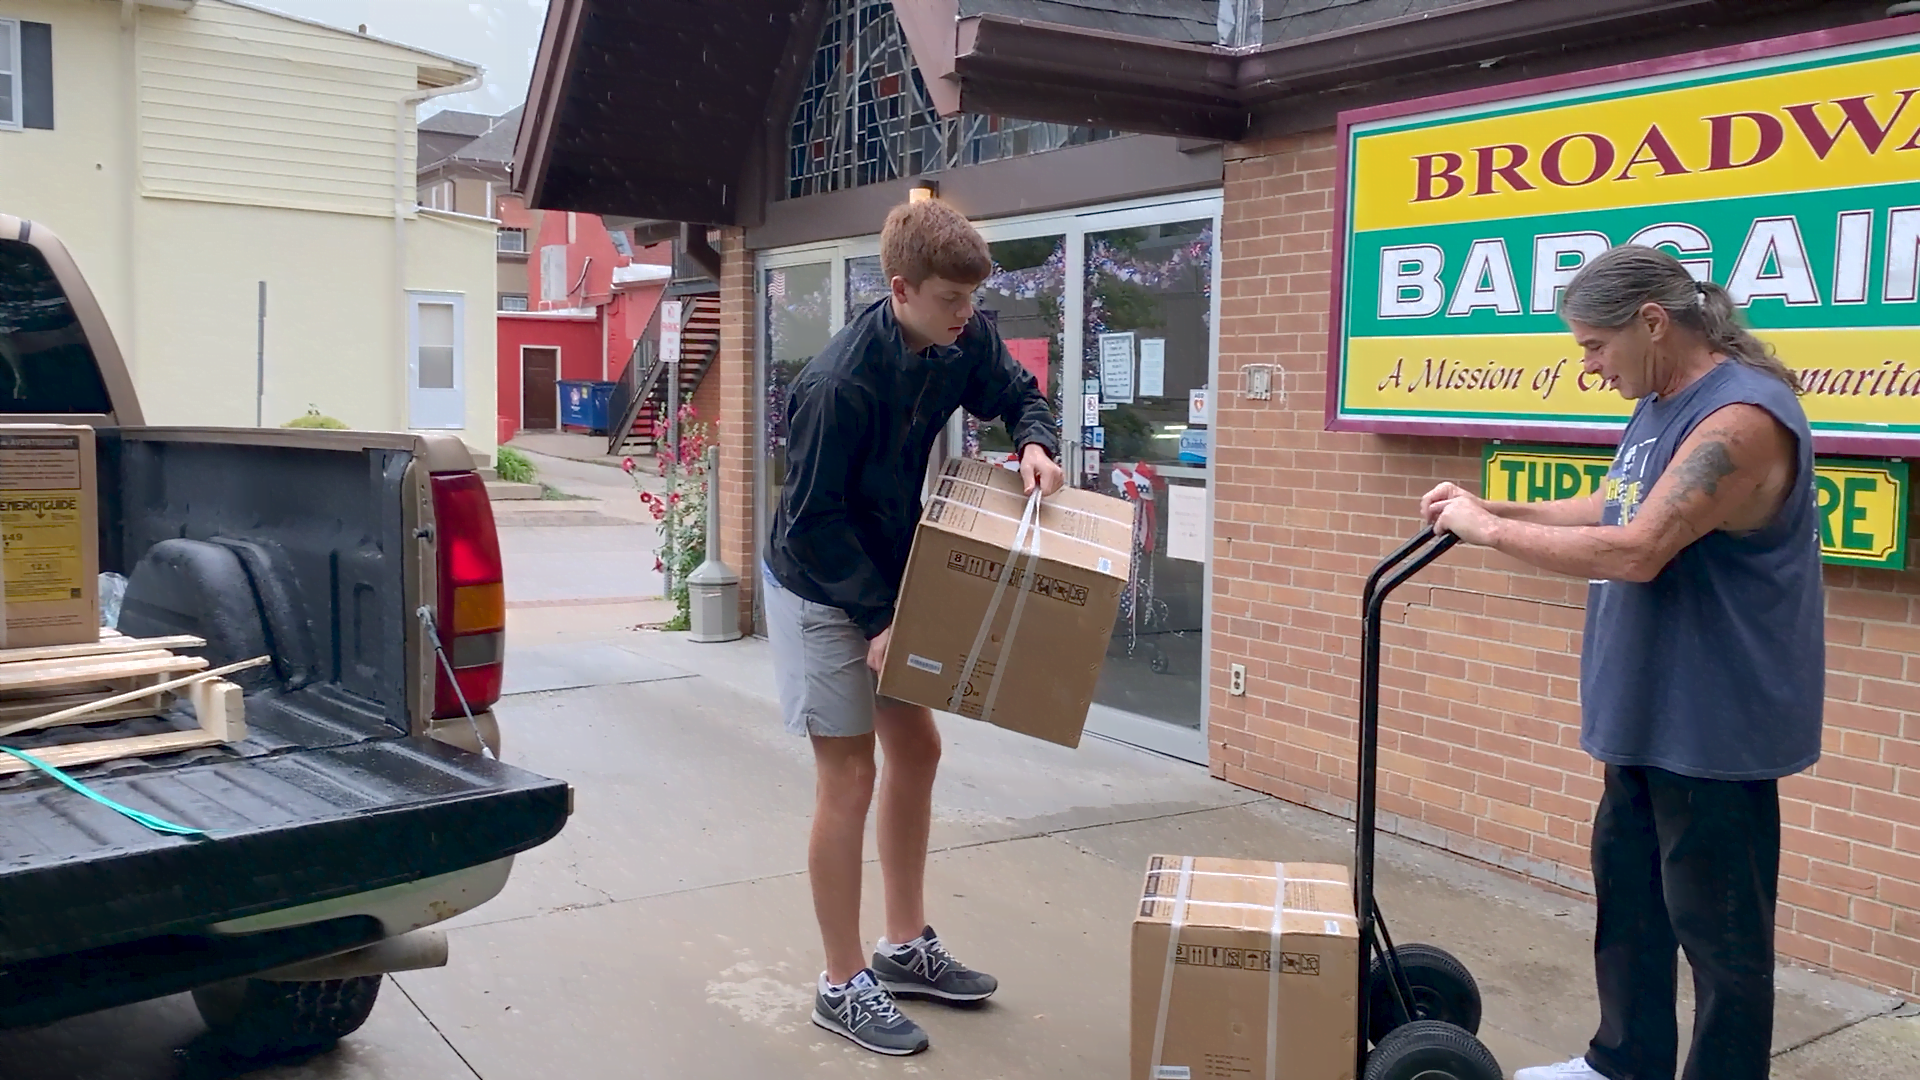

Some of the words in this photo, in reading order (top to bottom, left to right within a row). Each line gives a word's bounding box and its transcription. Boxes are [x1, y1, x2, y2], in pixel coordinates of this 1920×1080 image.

[1377, 358, 1404, 392] A
[1408, 358, 1525, 394] Mission
[1531, 358, 1568, 401] of
